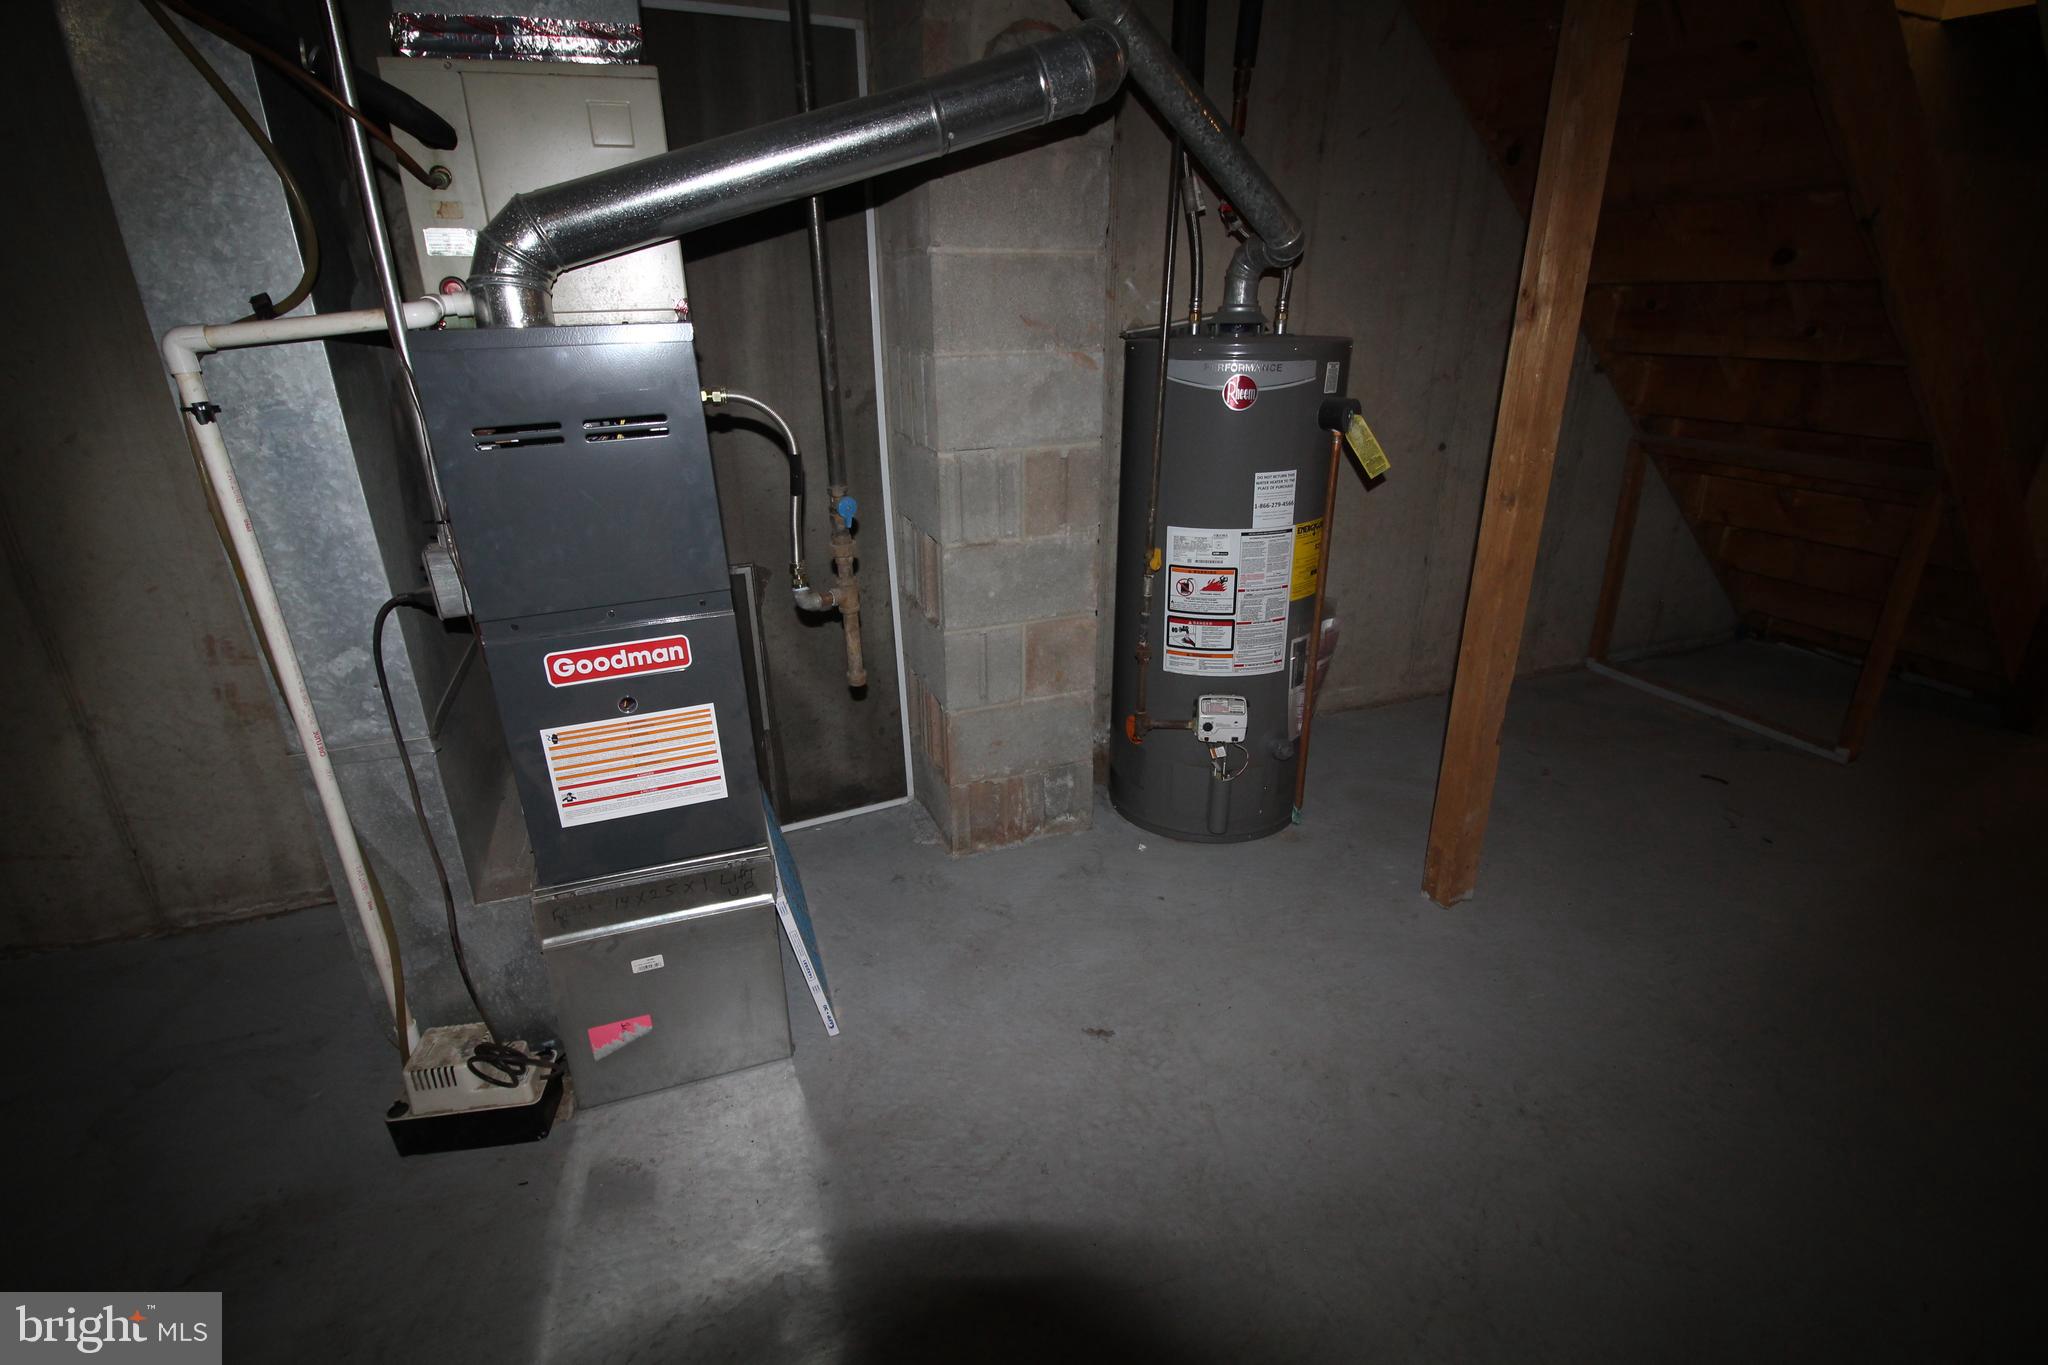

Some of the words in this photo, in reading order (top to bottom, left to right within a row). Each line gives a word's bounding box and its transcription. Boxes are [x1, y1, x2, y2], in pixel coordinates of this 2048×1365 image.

[1203, 363, 1283, 373] PRFORMANCE
[1227, 375, 1256, 405] Rheem
[552, 645, 685, 678] Goodman
